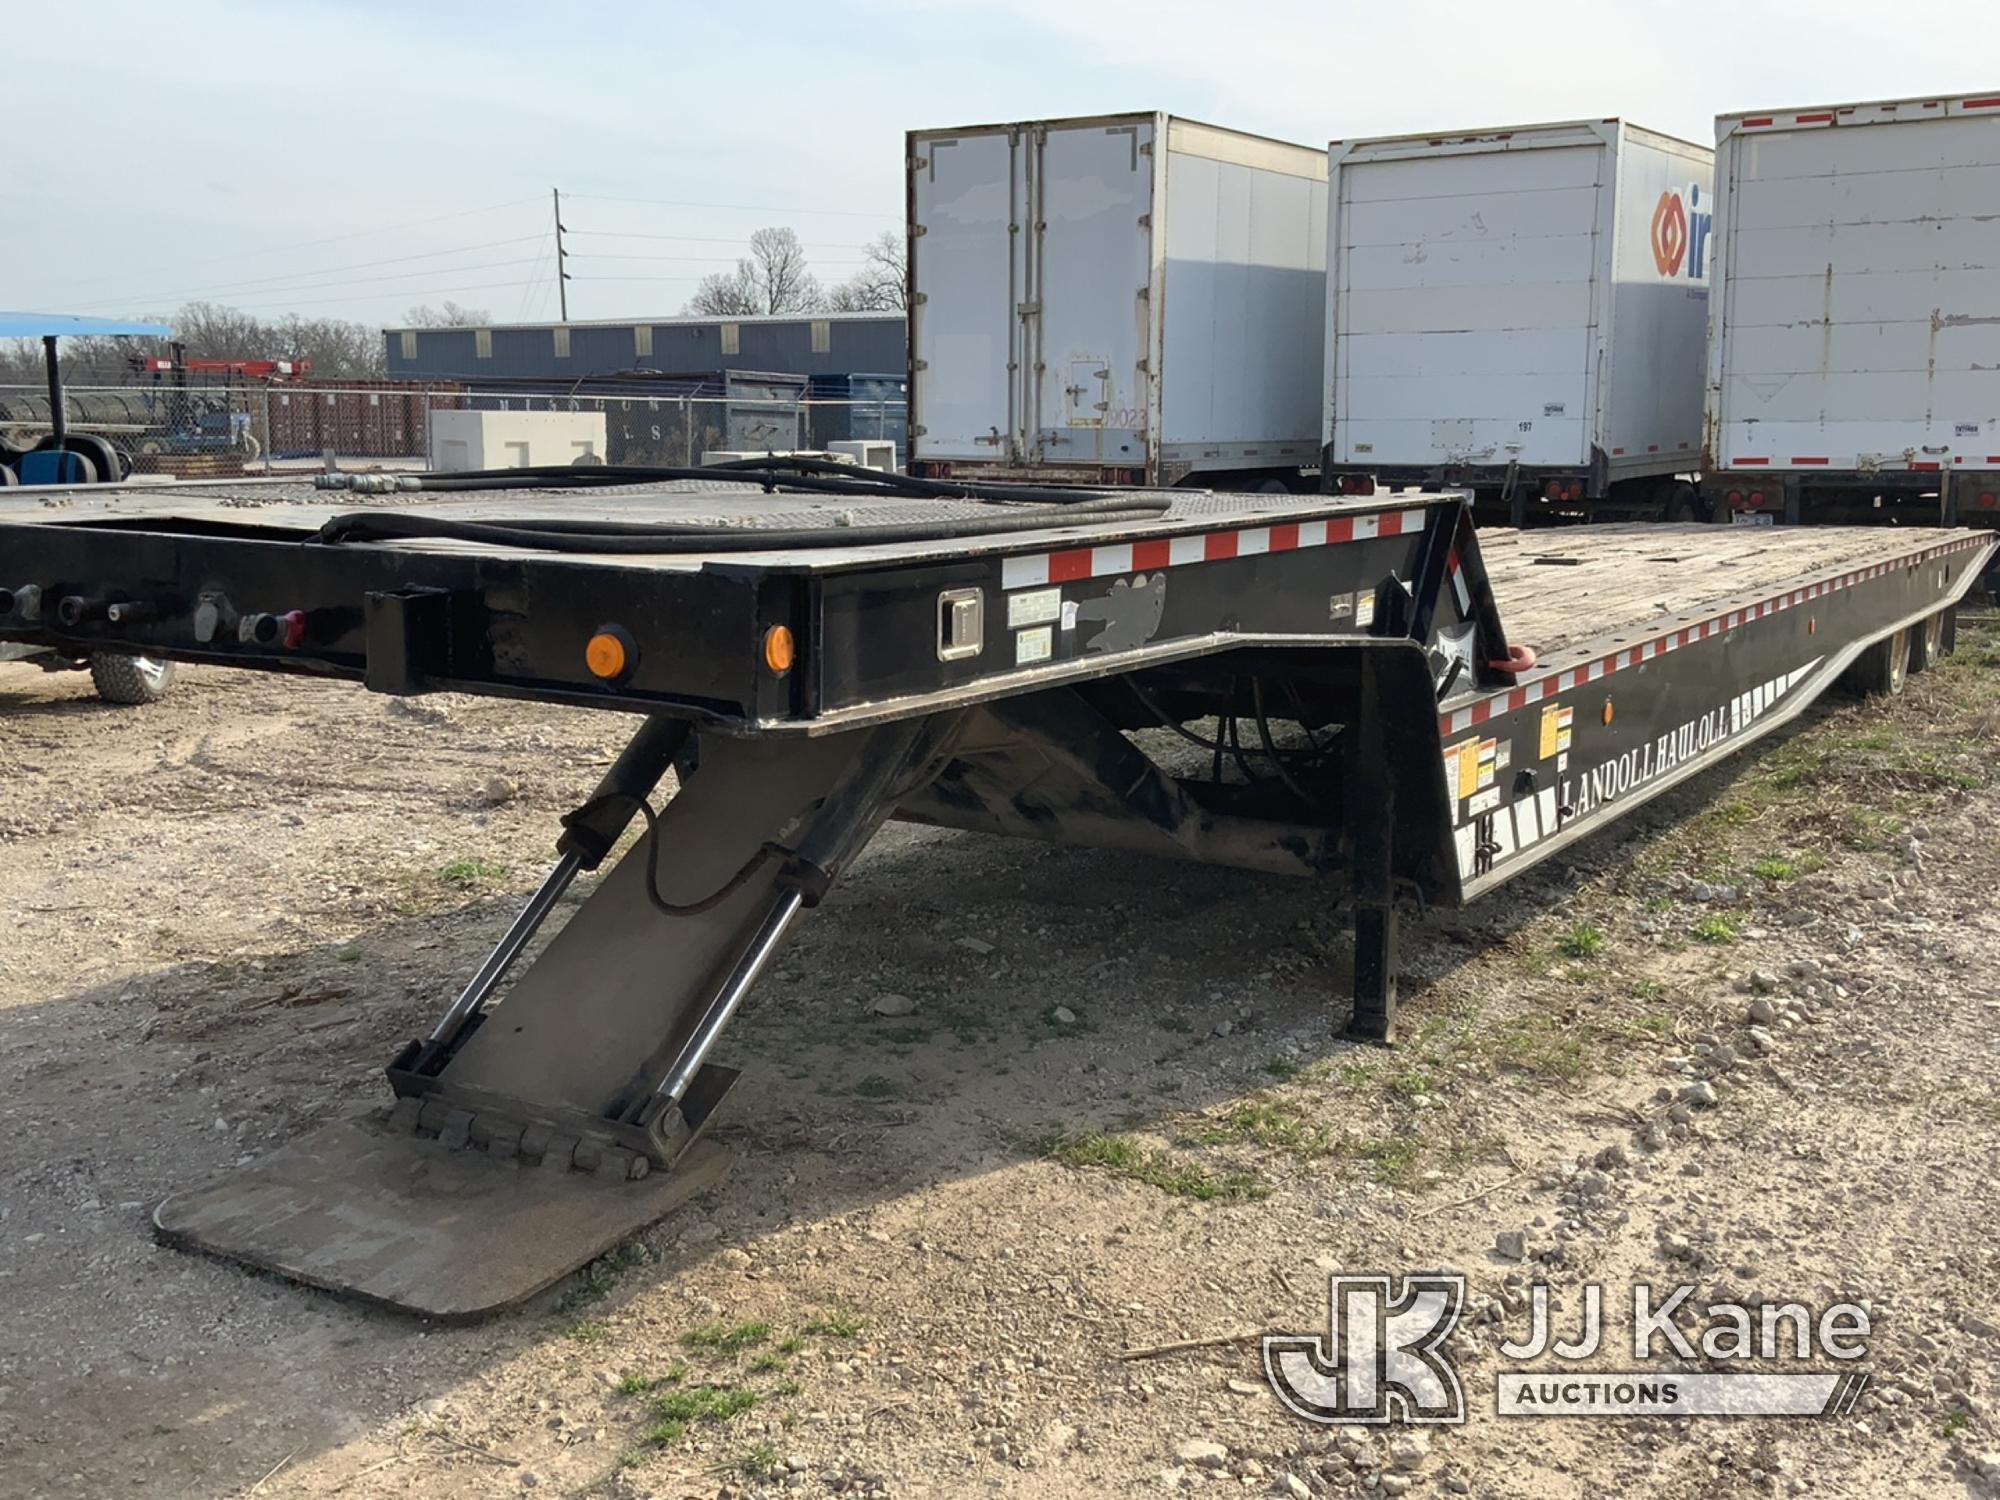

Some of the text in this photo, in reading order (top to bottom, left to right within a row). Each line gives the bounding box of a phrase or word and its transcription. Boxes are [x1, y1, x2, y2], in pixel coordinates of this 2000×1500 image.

[1518, 421, 1533, 432] 197
[1561, 742, 1656, 824] LANDOLL
[1654, 705, 1729, 776] HAULOLL
